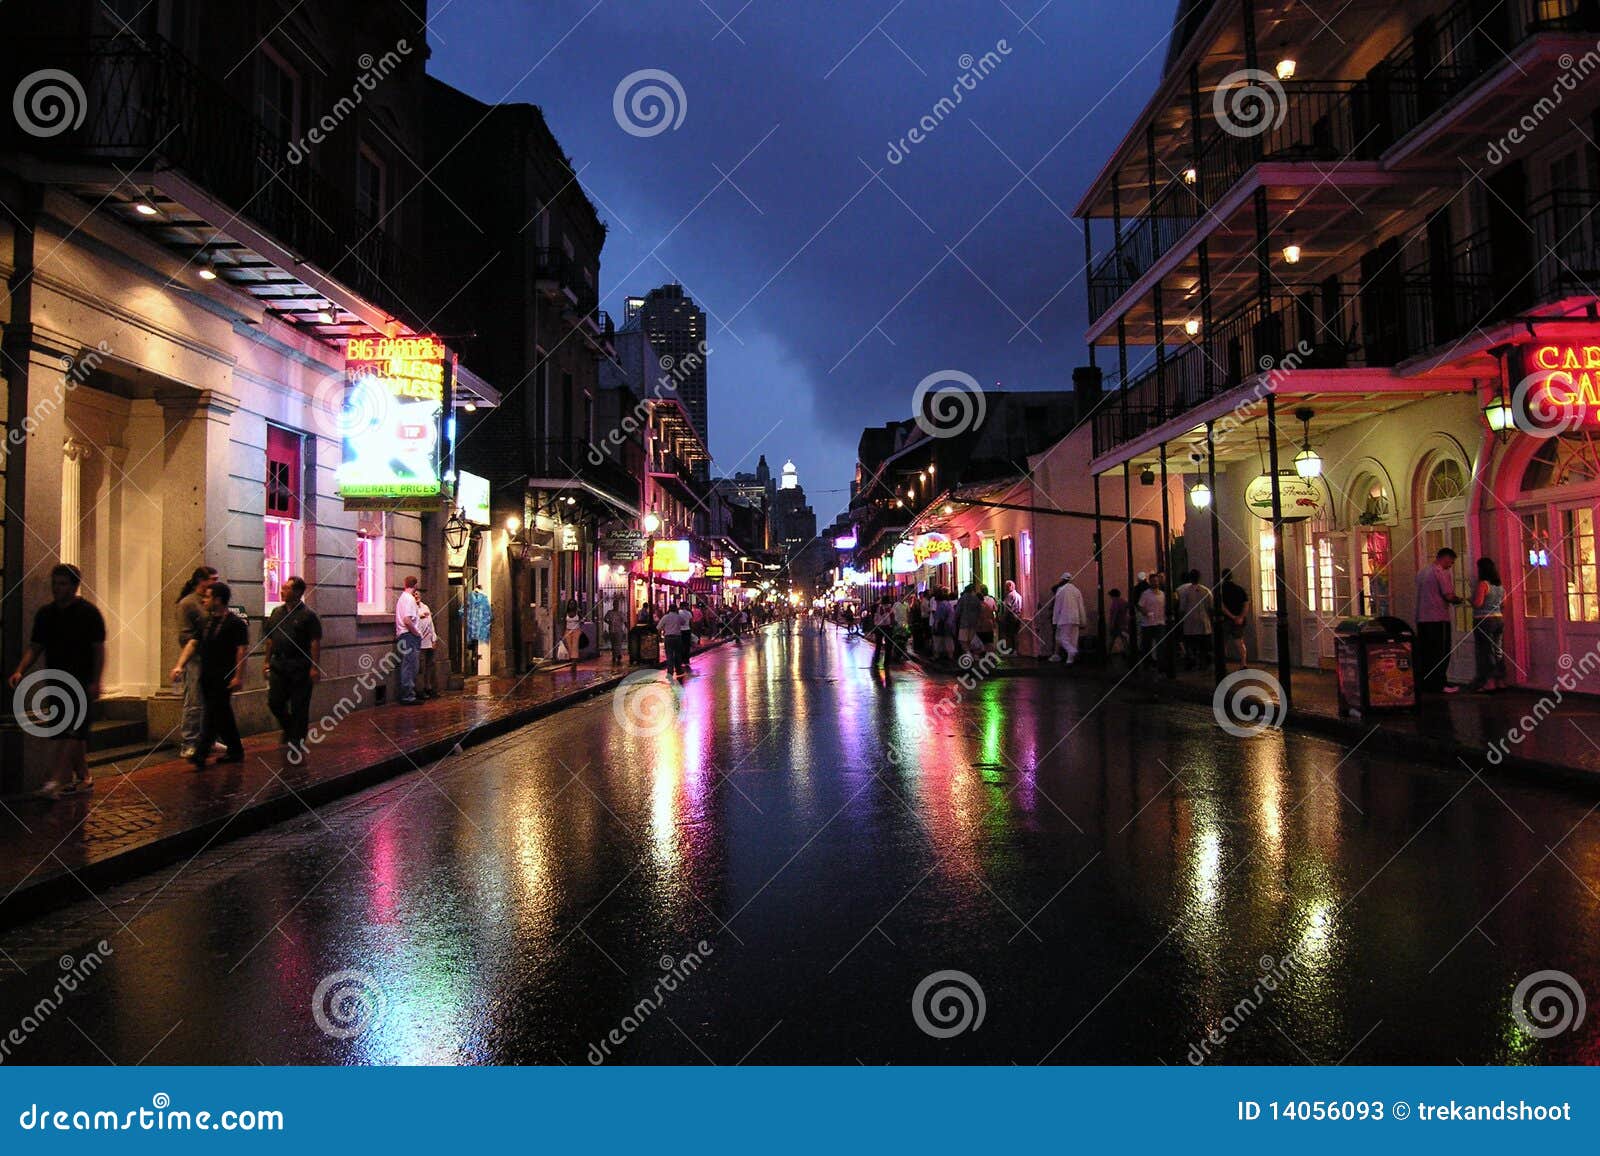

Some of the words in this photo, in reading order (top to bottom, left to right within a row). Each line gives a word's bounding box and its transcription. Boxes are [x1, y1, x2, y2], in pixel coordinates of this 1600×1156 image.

[347, 338, 374, 361] BIG
[1546, 371, 1600, 405] GA
[343, 484, 395, 494] MODERATE
[400, 484, 437, 494] PRICES
